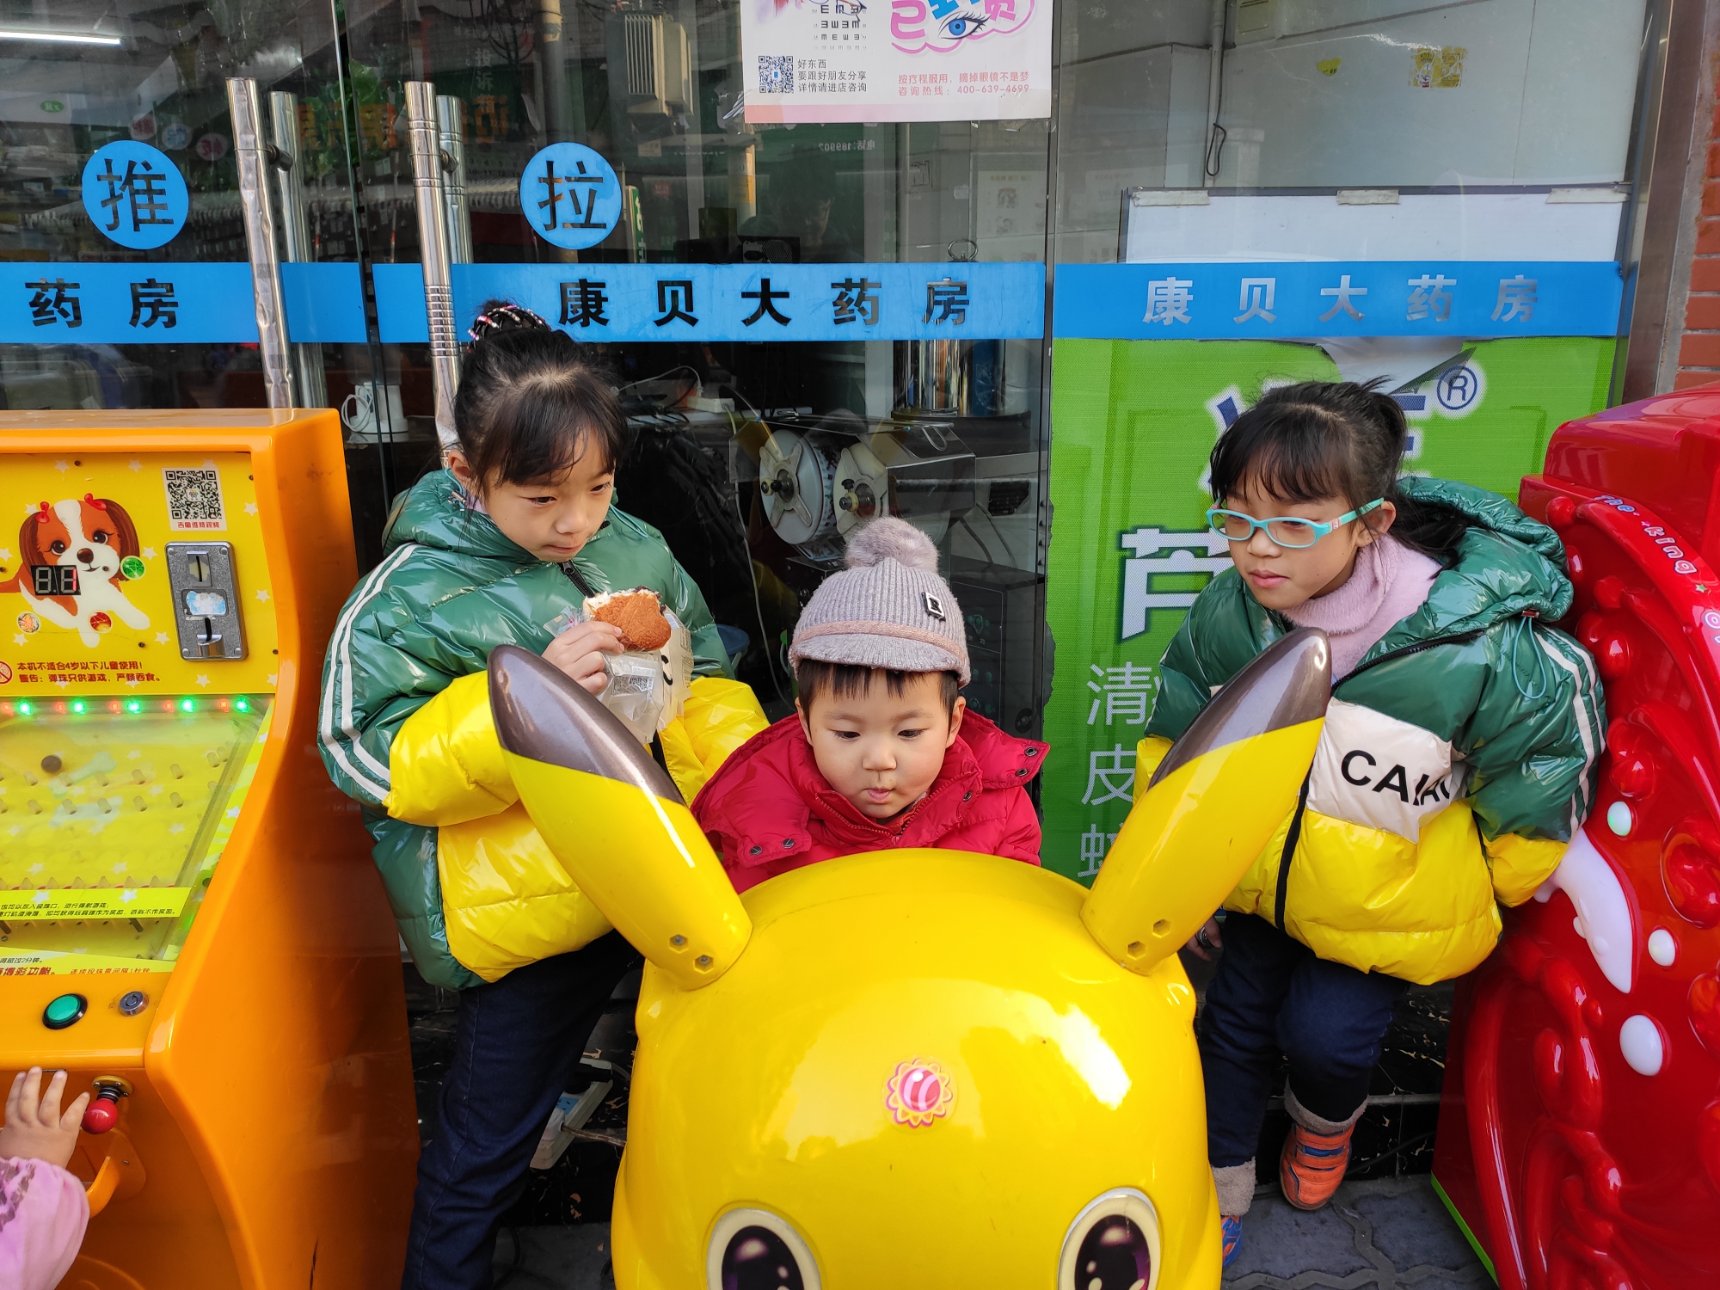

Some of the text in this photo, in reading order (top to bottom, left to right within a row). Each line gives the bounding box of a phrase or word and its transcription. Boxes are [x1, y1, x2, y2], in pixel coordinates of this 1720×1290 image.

[797, 59, 827, 69] 好东西
[797, 71, 867, 81] 要跟好朋友分享
[797, 83, 867, 93] 详情请进店咨询
[96, 159, 175, 233] 推
[538, 160, 607, 230] 拉
[24, 277, 180, 330] 药房
[558, 276, 971, 327] 康贝大药房
[1142, 273, 1539, 326] 康贝大药房
[1086, 661, 1160, 725] 清
[1081, 743, 1136, 806] 皮
